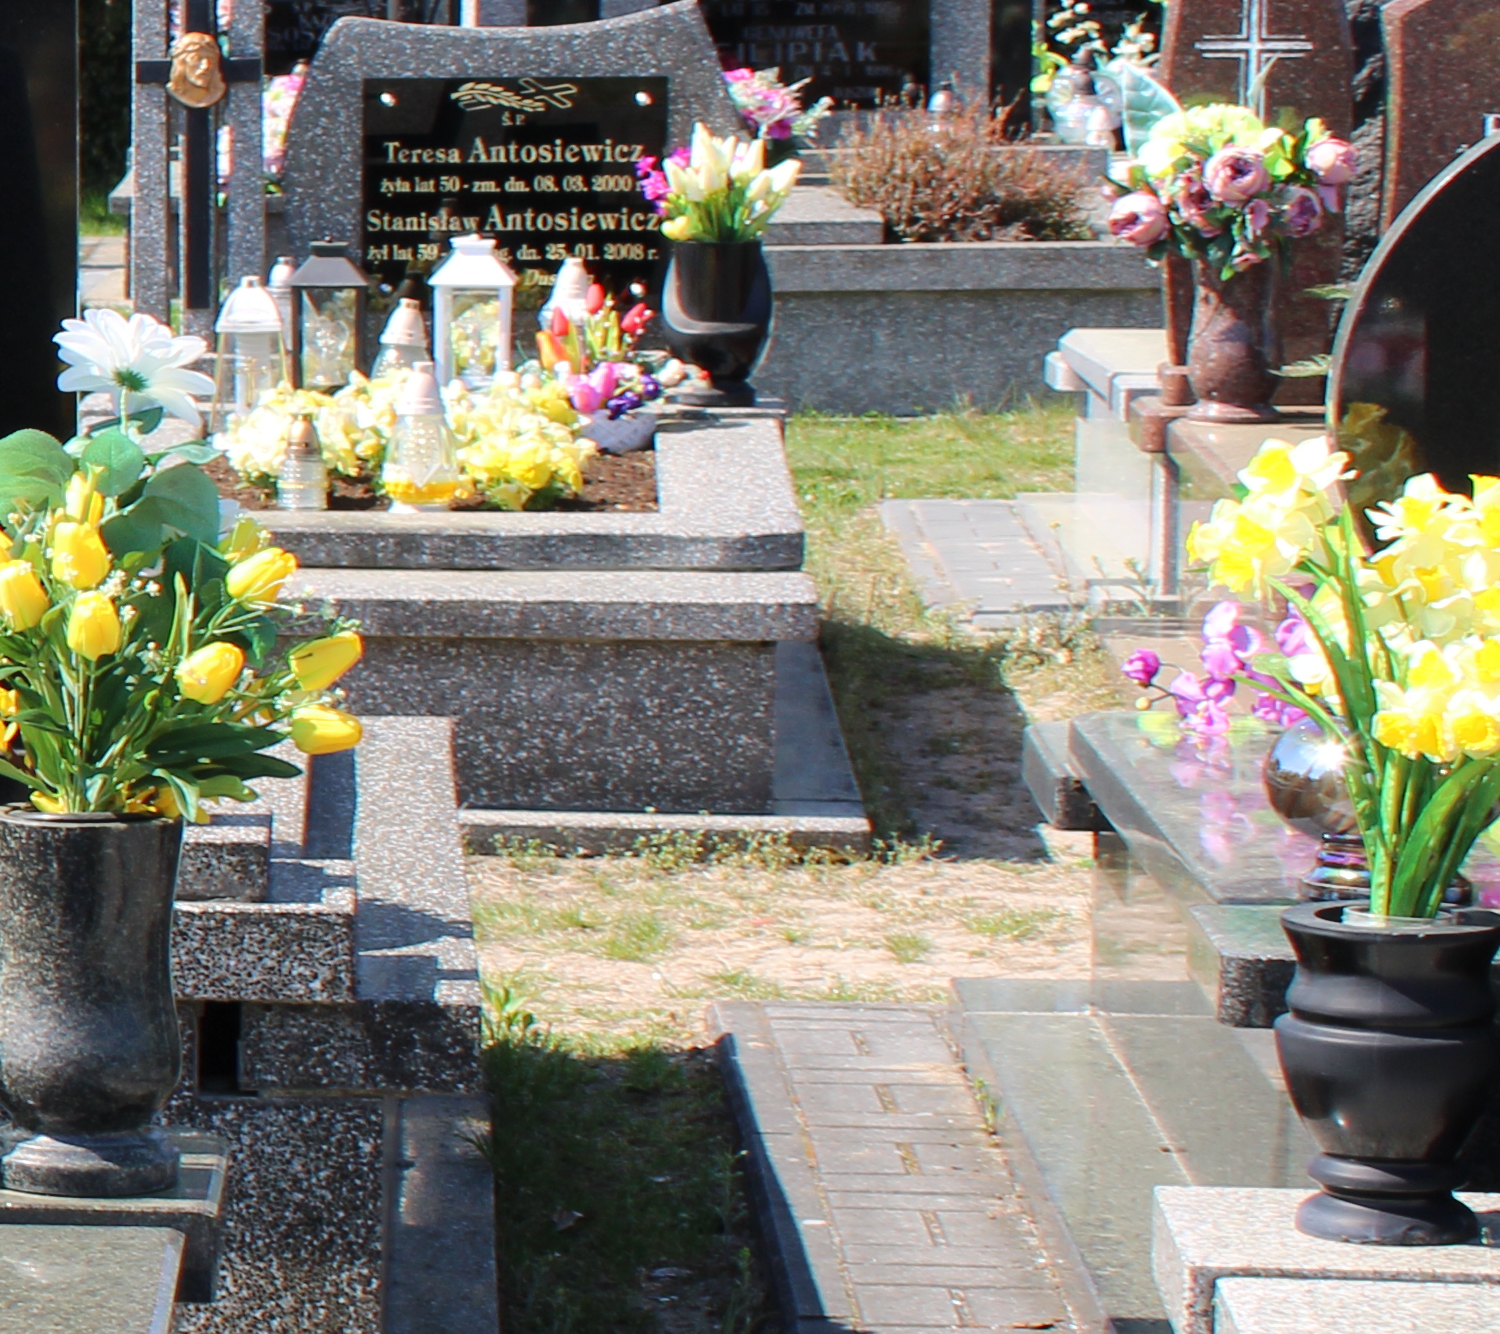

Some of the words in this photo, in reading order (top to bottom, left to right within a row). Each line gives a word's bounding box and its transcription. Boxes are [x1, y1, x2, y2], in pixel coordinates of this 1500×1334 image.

[384, 140, 462, 164] Teresa
[467, 136, 644, 164] Antosiewicz
[414, 176, 436, 192] lat
[439, 175, 461, 193] 50
[472, 180, 501, 193] zm.
[504, 175, 530, 193] dn.
[591, 175, 633, 193] 2000
[366, 208, 480, 232] Stanisław
[484, 204, 661, 232] Antosiewicz
[392, 243, 413, 260] lat
[516, 243, 543, 260] dn.
[603, 242, 645, 260] 2008
